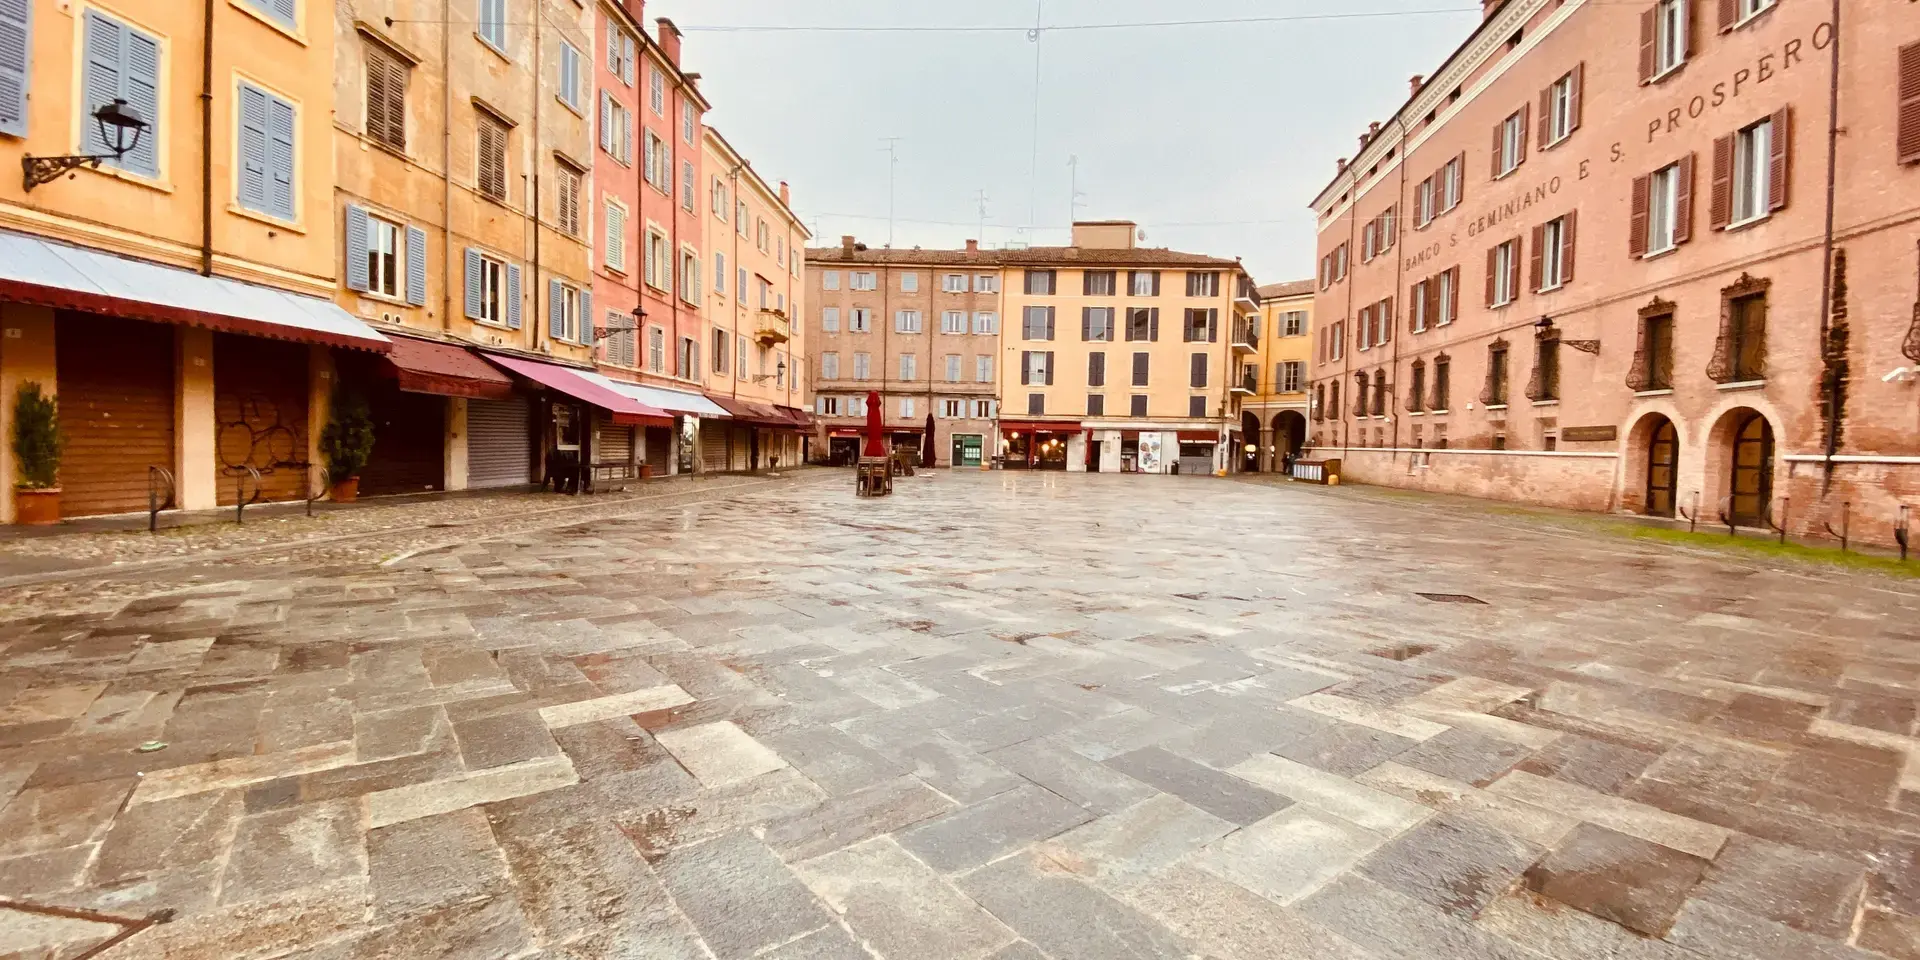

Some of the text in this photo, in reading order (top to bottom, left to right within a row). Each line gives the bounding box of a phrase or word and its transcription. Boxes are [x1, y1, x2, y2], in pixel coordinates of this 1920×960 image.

[1405, 242, 1440, 271] BANCO
[1468, 176, 1561, 237] GEMINIANO
[1578, 159, 1590, 180] E
[1648, 22, 1833, 143] PROSPERO
